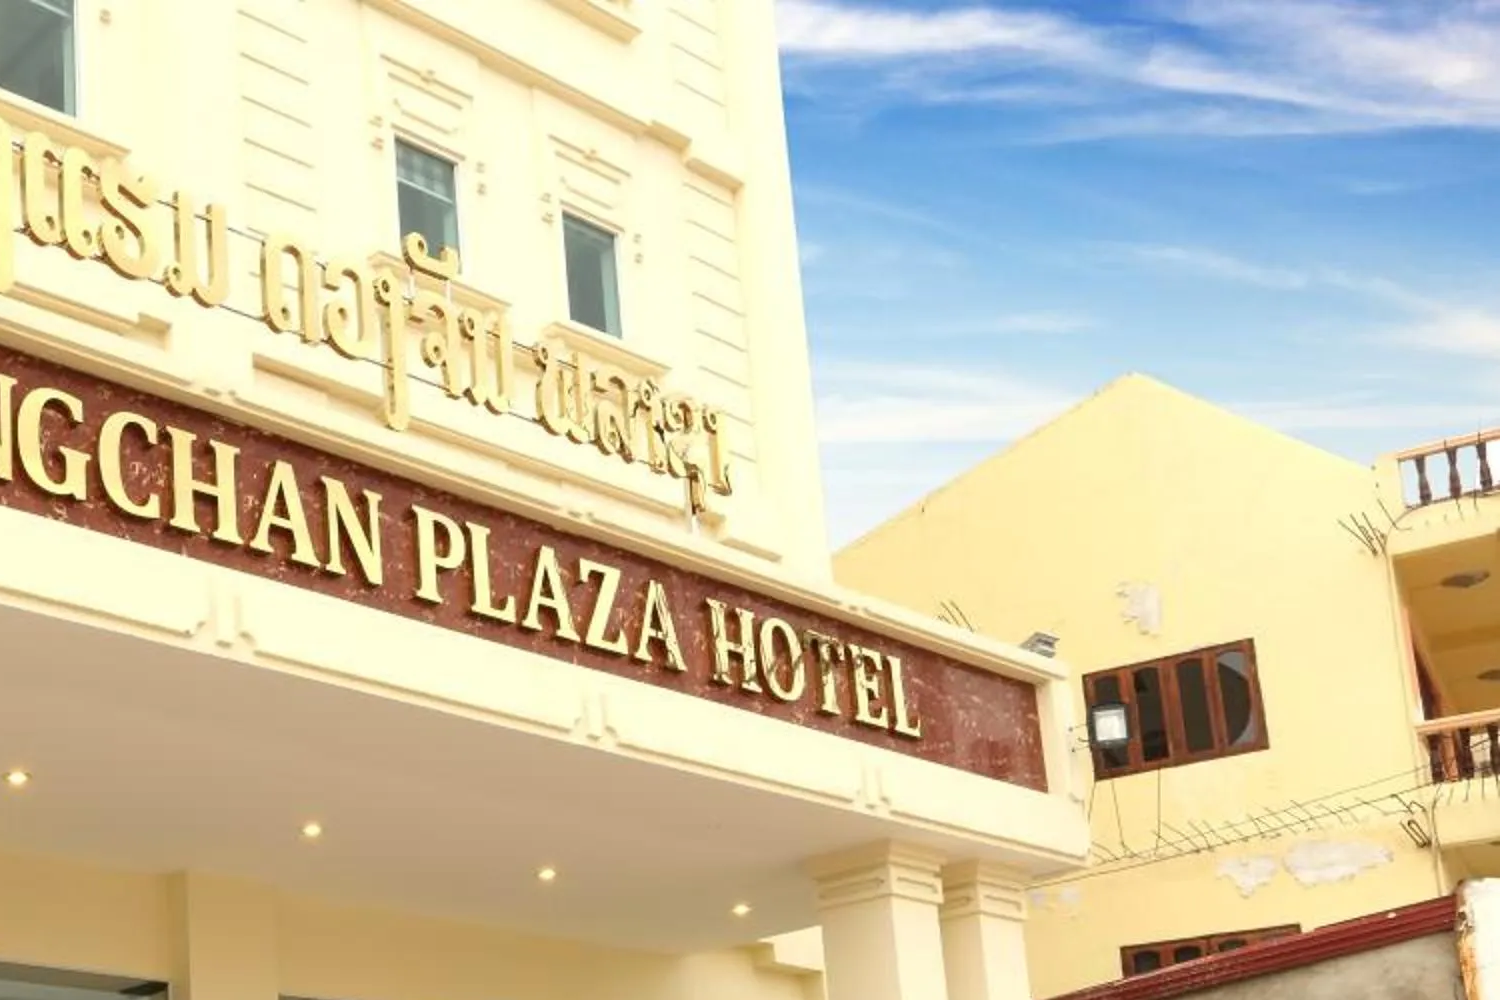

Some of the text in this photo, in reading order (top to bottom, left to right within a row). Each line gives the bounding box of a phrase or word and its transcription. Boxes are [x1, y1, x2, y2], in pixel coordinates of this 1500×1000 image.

[260, 232, 513, 432] ດວງຈັນ
[411, 503, 688, 674] PLAZA
[704, 597, 922, 740] HOTEL
